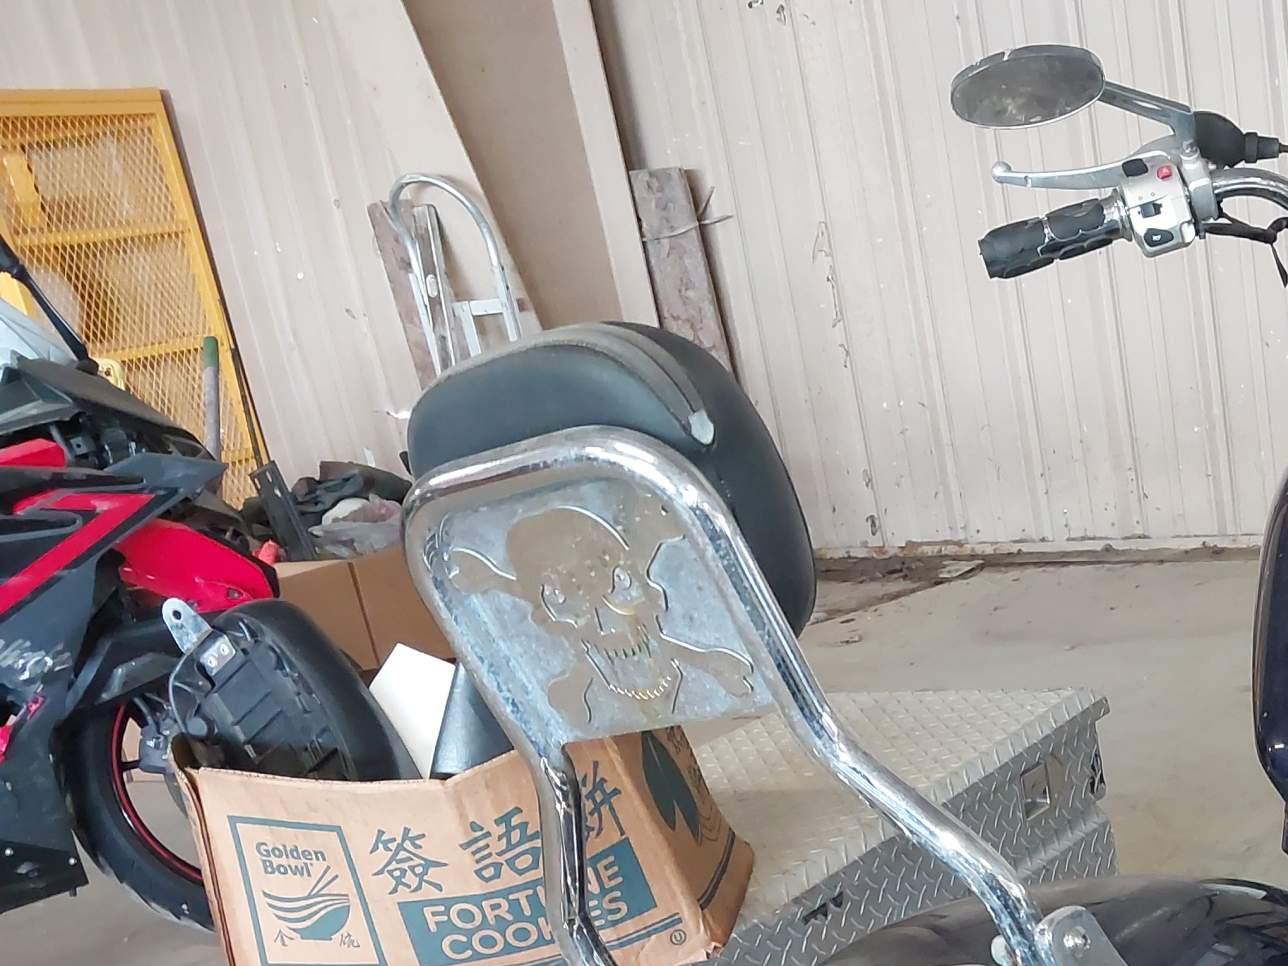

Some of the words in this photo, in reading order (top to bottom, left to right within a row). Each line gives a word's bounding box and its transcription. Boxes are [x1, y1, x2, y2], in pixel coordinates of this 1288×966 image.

[255, 841, 327, 862] Golden
[262, 859, 312, 878] Bowl
[423, 855, 623, 933] FORTE
[441, 890, 628, 960] COOES
